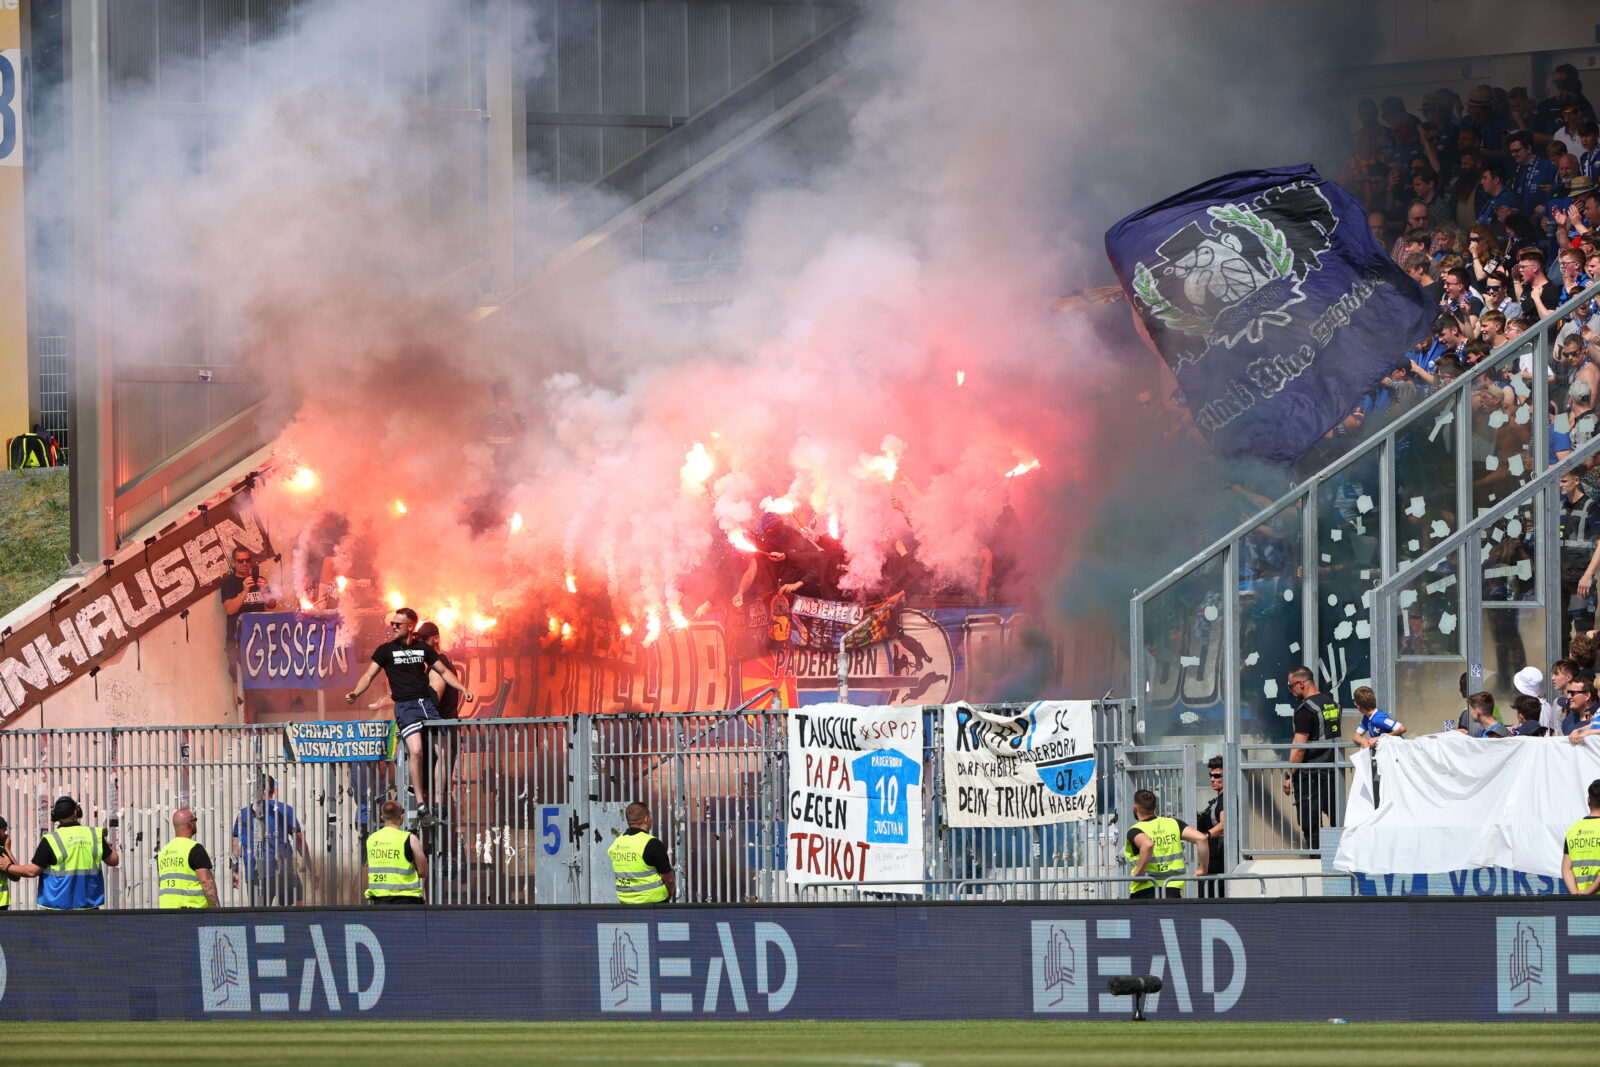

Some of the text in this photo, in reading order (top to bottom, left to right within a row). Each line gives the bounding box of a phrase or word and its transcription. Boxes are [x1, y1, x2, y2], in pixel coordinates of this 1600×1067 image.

[245, 621, 348, 678] GESSELN
[292, 722, 389, 739] SCHNAPS & WEED
[795, 714, 861, 751] TAUSCHE
[1052, 709, 1069, 734] SC
[297, 740, 388, 757] AUSWÄRTSSIEG!
[871, 756, 903, 767] PADERBORN
[1017, 738, 1076, 765] PADERBORN
[806, 753, 851, 792] PAPA
[1056, 768, 1073, 791] 07
[875, 775, 898, 815] 10
[958, 786, 989, 817] DEIN
[995, 782, 1045, 819] TRIKOT
[791, 790, 847, 830] GEGEN
[542, 807, 561, 856] 5
[874, 820, 904, 836] JUSTVAN
[370, 849, 400, 860] RDNER
[612, 852, 638, 862] RDNER
[790, 833, 870, 881] TRIKOT
